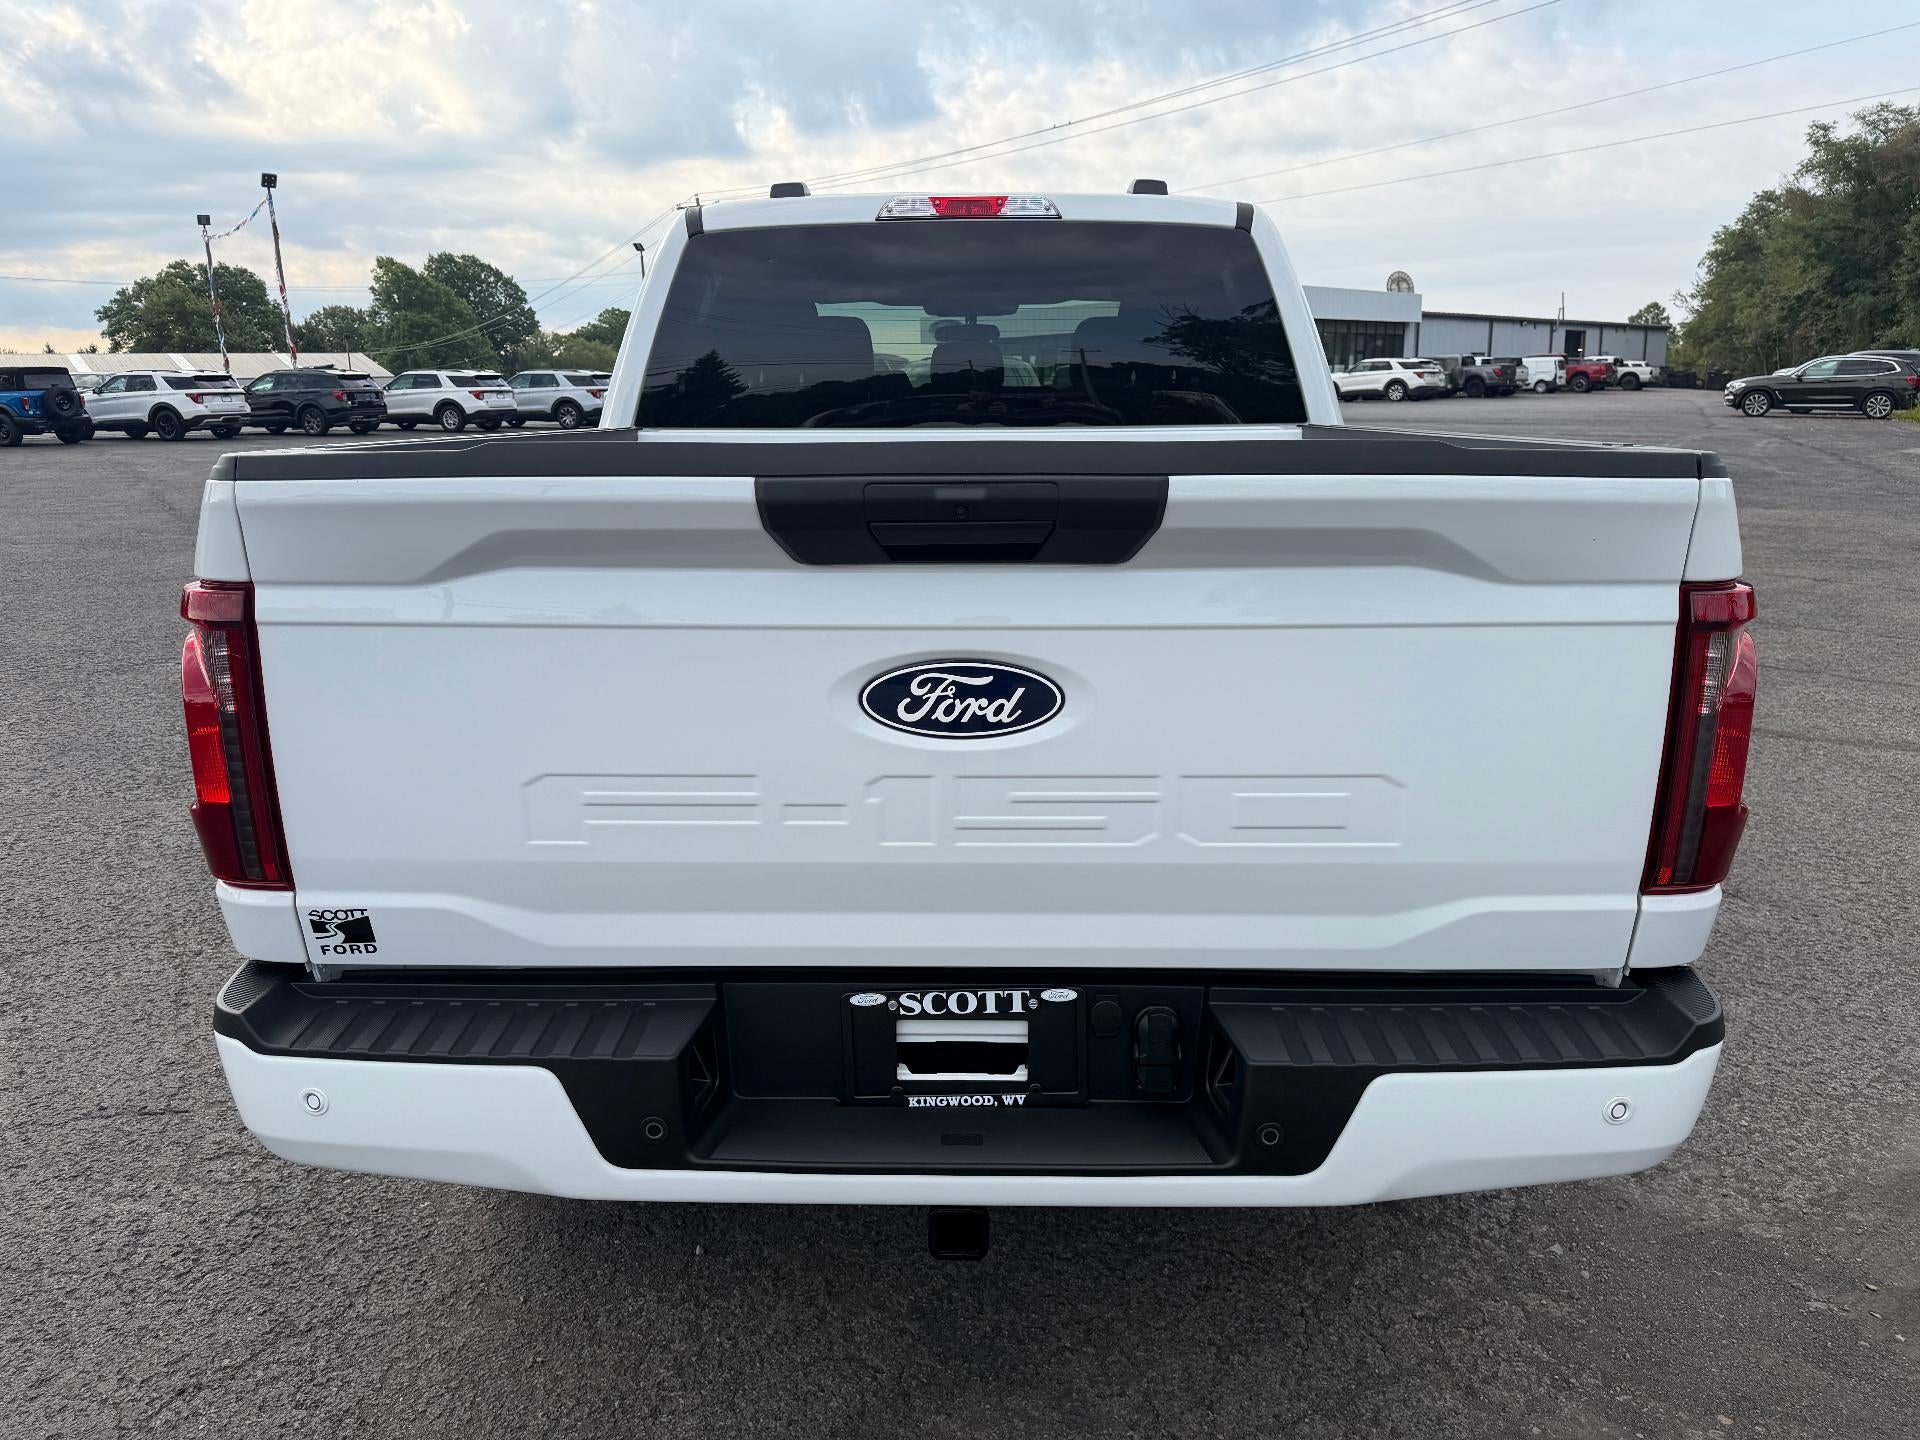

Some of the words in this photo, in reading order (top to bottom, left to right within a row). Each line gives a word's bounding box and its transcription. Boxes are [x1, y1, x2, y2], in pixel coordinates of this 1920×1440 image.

[897, 672, 1026, 723] Ford
[522, 772, 1406, 848] F-150
[308, 909, 367, 921] SCOTT
[320, 944, 378, 955] FORD
[899, 990, 1030, 1016] SCOTT
[908, 1095, 999, 1107] KINGWOOD,
[1001, 1094, 1027, 1106] WV
